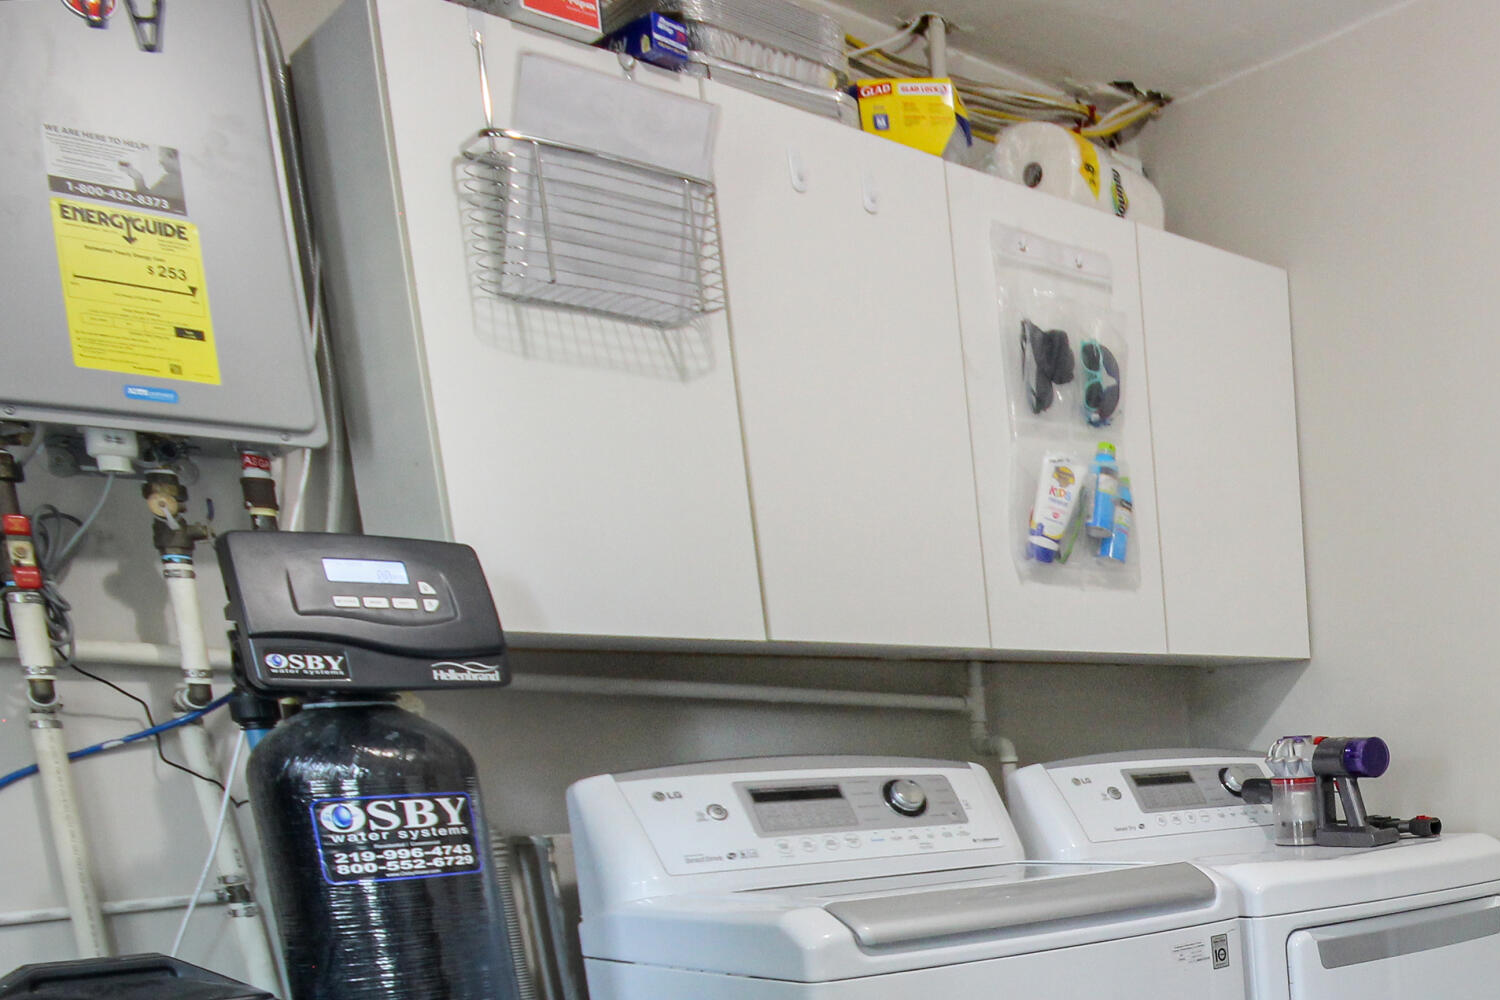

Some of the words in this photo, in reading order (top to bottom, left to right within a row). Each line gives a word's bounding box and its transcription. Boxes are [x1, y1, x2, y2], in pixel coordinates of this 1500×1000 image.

[860, 84, 891, 97] GLAD
[61, 127, 80, 137] ARE
[82, 131, 107, 142] HERE
[109, 136, 121, 145] TO
[65, 181, 169, 209] 1-800-432-8373
[59, 203, 189, 244] ENERGYGUIDE
[158, 265, 187, 281] 253
[1049, 486, 1071, 501] KIDS
[265, 653, 344, 670] OSBY
[432, 668, 501, 682] Hellenbrand
[1080, 777, 1092, 785] LG
[667, 791, 683, 799] LG
[320, 797, 466, 833] OSBY
[329, 831, 390, 843] water
[397, 825, 469, 841] systems
[334, 844, 473, 864] 219-996-4743
[336, 855, 474, 875] 800-552-6729
